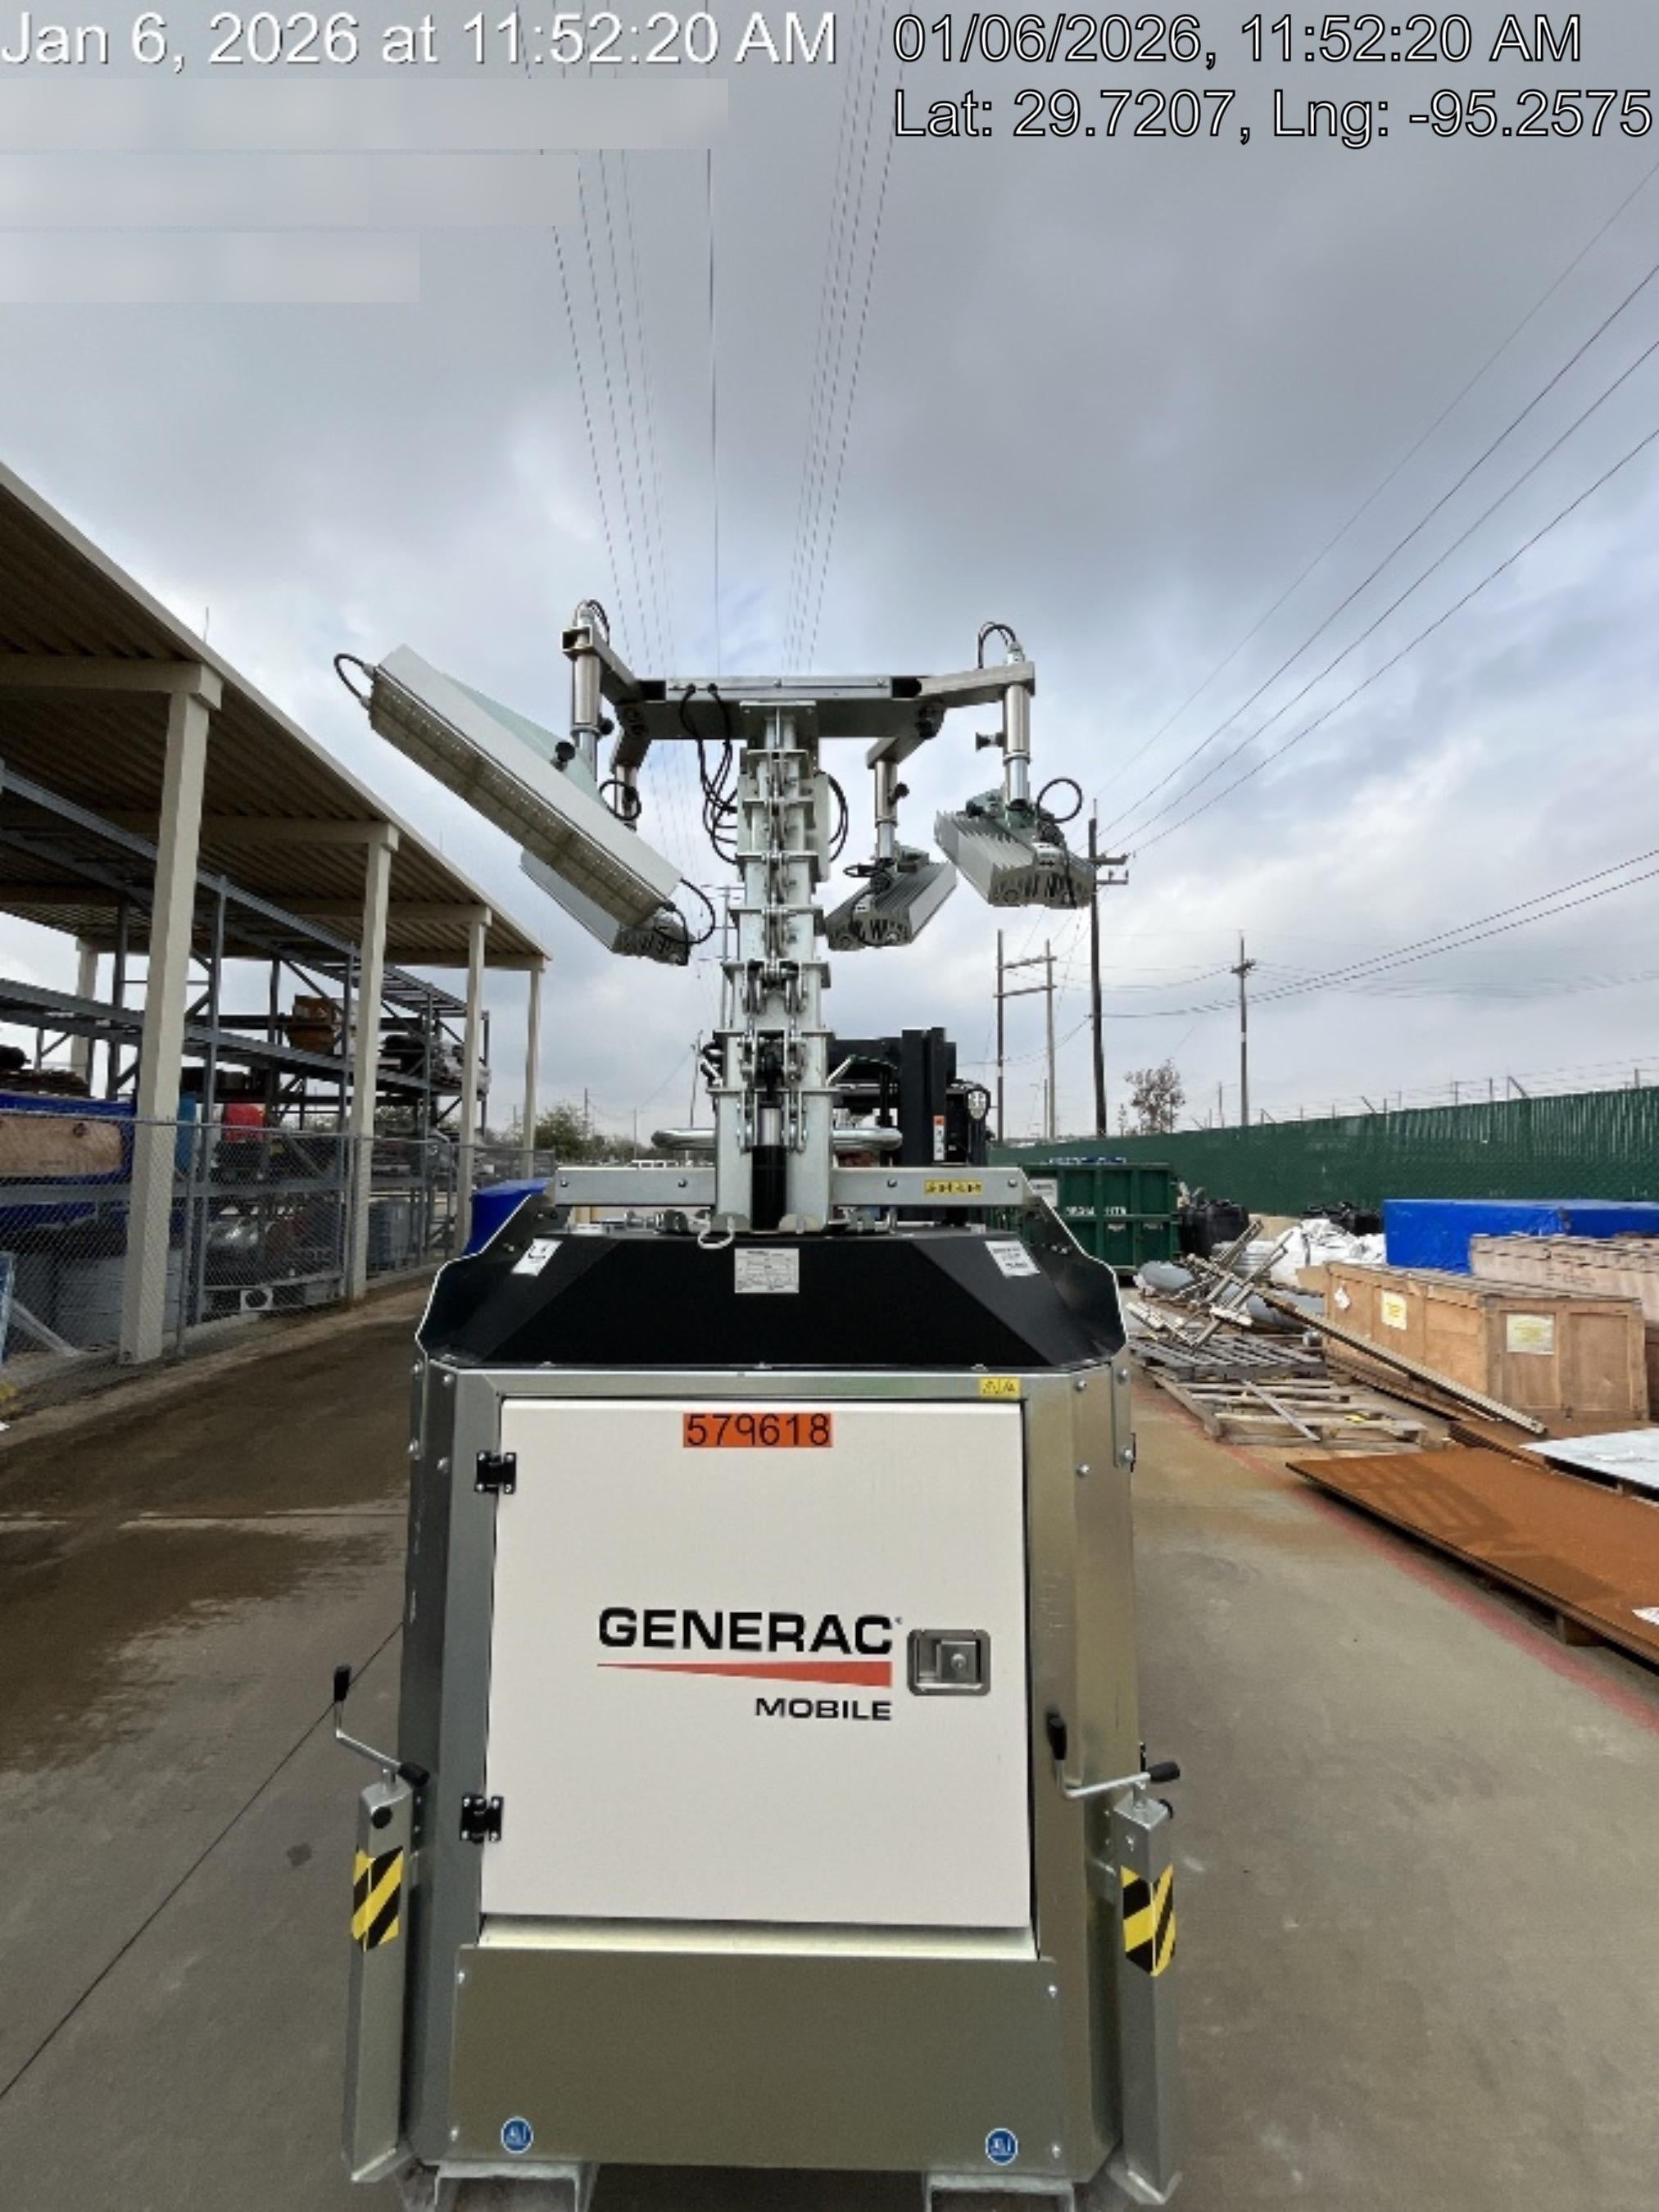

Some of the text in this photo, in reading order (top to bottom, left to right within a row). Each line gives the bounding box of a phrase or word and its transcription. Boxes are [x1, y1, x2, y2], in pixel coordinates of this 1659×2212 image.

[687, 1412, 830, 1446] 579618
[599, 1607, 893, 1655] GENERAC
[755, 1698, 892, 1720] MOBILE
